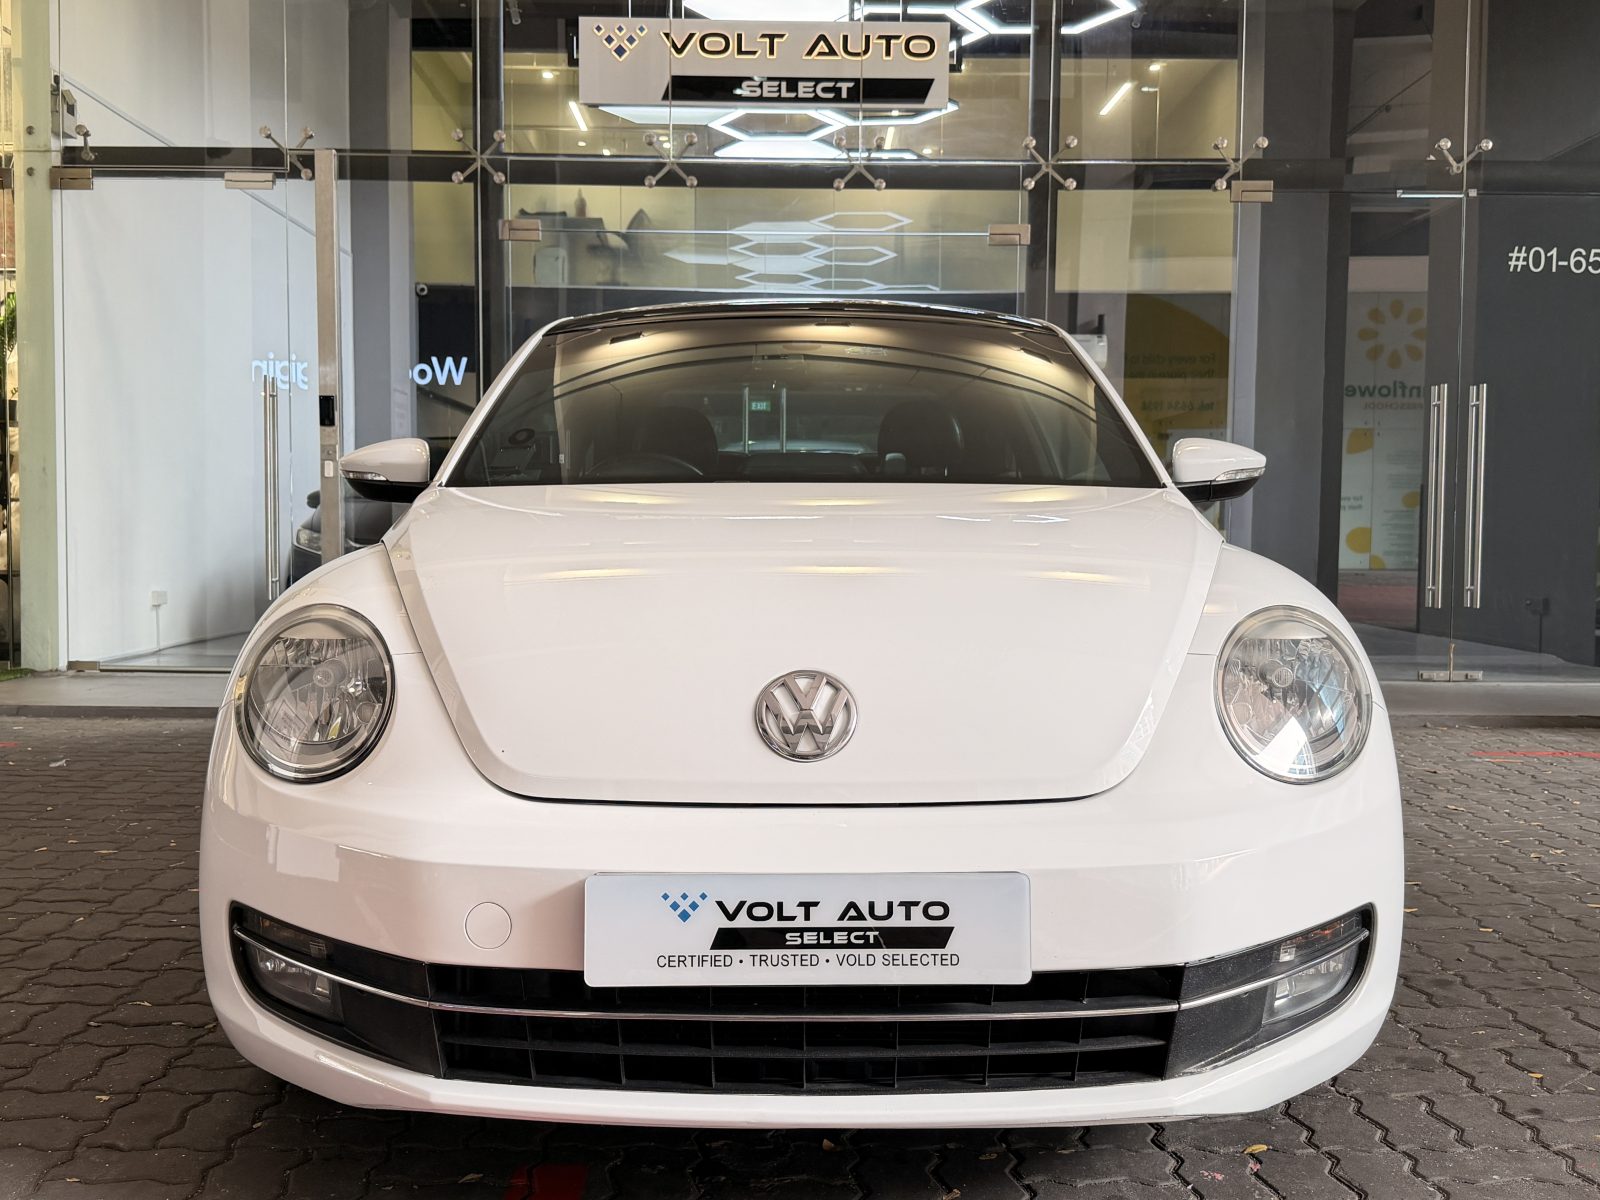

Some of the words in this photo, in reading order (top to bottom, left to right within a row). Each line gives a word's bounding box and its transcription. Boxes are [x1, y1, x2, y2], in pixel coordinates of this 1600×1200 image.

[660, 31, 788, 59] VOLT
[803, 33, 937, 61] AUTO
[740, 80, 855, 99] SELECT
[1507, 245, 1600, 275] #01-65
[715, 900, 820, 922] VOLT
[837, 900, 950, 922] AUTO
[785, 930, 879, 945] SELECT
[656, 953, 733, 968] CERTIFIED
[750, 953, 820, 968] TRUSTED
[836, 952, 878, 967] VOLD
[881, 952, 960, 968] SELECTED
